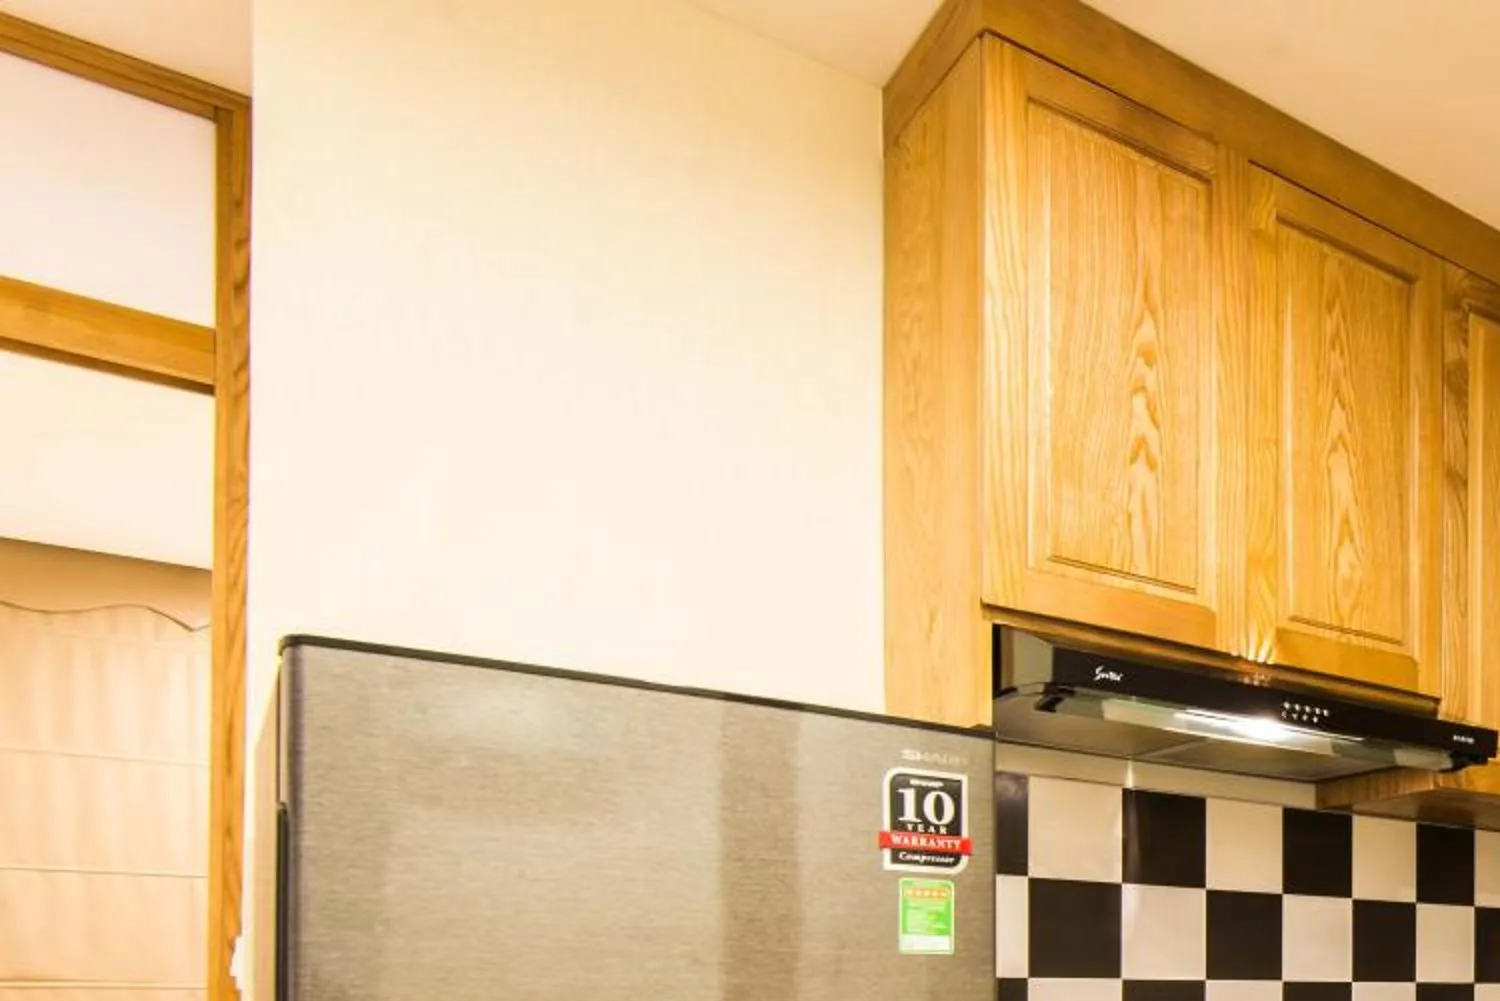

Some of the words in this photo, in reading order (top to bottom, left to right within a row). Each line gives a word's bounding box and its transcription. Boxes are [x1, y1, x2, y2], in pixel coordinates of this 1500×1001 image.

[897, 787, 955, 826] 10
[906, 823, 948, 835] YEAR
[890, 834, 962, 849] WARRANTY
[898, 851, 955, 864] Compressor
